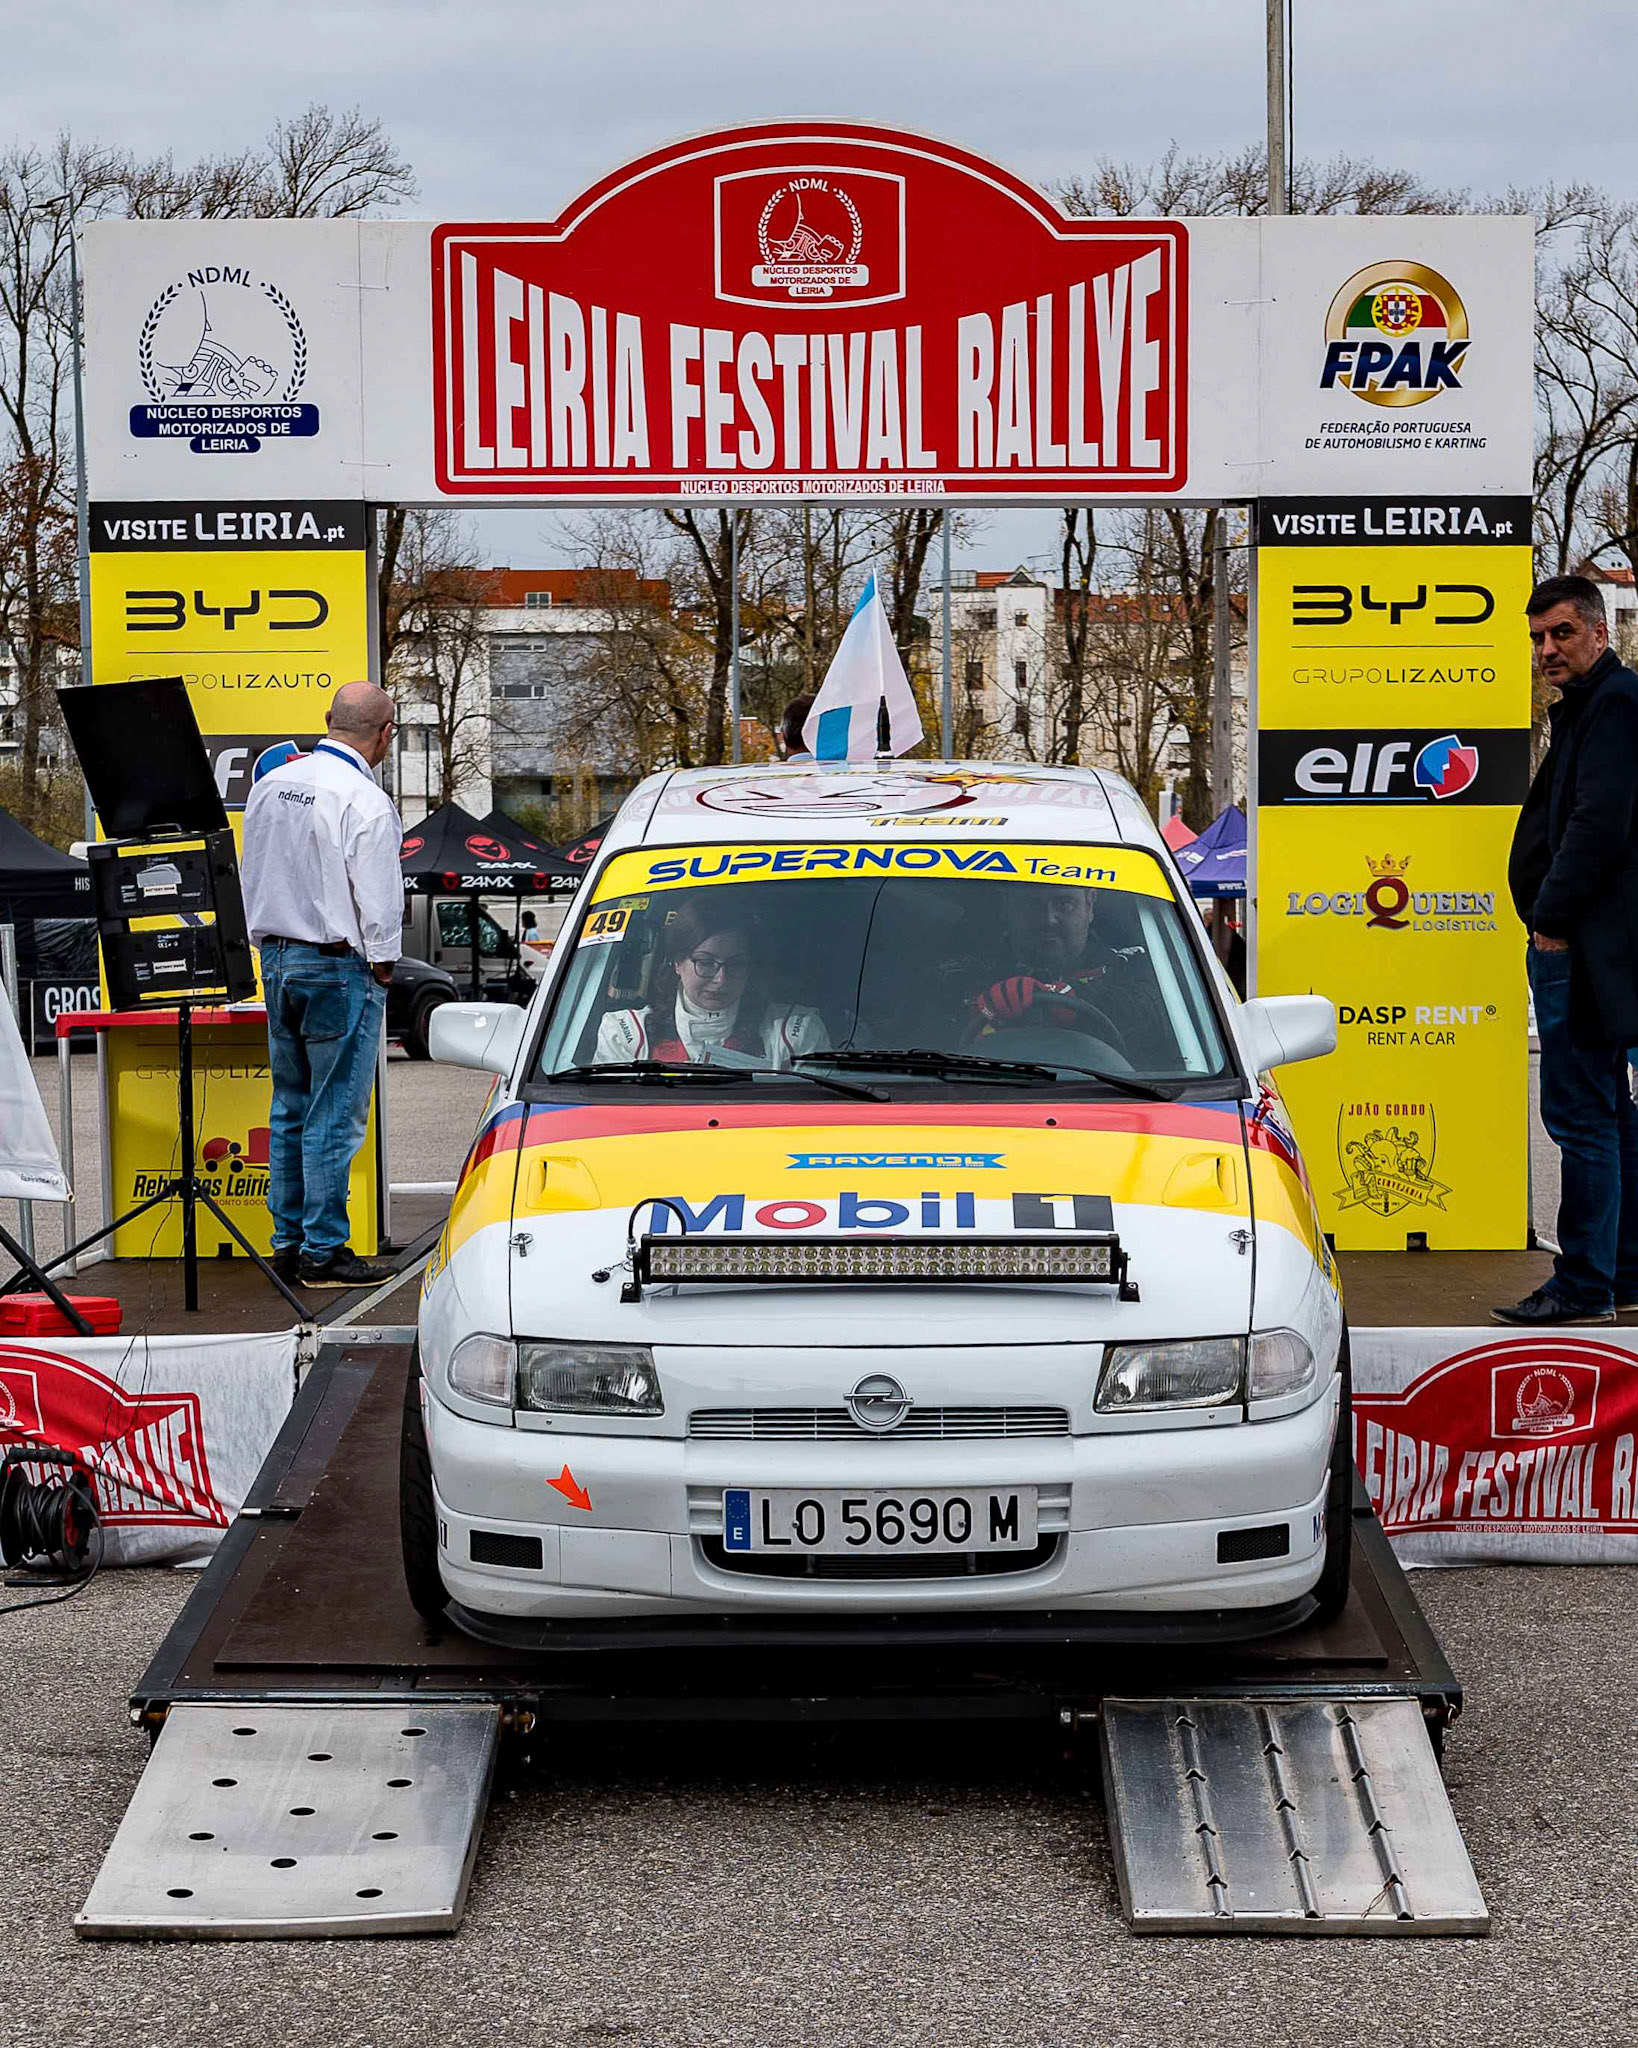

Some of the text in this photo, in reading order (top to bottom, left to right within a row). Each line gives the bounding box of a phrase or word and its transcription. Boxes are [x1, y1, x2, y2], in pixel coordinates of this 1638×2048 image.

[787, 178, 829, 193] NDML
[187, 266, 251, 288] NDML
[802, 266, 858, 275] DESPORTOS
[770, 276, 851, 285] MOTORIZADOS DE
[796, 286, 825, 295] LEIRIA
[461, 247, 1162, 470] LEIRIA FESTIVAL RALLYE
[1320, 341, 1472, 389] FPAK
[146, 404, 302, 420] NÚCLEO DESPORTOS
[158, 422, 291, 436] MOTORIZADOS DE
[1320, 421, 1471, 436] FEDERAÇÃO PORTUGUESA
[201, 437, 249, 451] LEIRIA
[1305, 438, 1486, 449] DE AUTOMOBILISMO E KARTING
[680, 479, 945, 494] NUCLEO DESPORTOS MOTORIZADOS DE LEIRIA
[103, 519, 187, 541] VISITE
[1272, 514, 1356, 536] VISITE
[125, 589, 329, 631] BYD
[1293, 584, 1495, 625] BYD
[128, 673, 331, 690] POLIZAUTO
[1293, 668, 1496, 684] GRUPOLIZAUTO
[1294, 742, 1411, 793] elf
[278, 790, 315, 806] ndml.pt
[646, 848, 1116, 885] SUPERNOVA Team
[461, 876, 514, 888] 24MX
[1286, 877, 1495, 931] LOGIQUEEN
[590, 910, 626, 934] 49
[1413, 919, 1498, 931] LOGÍSTICA
[1339, 1006, 1406, 1024] DASP
[1368, 1032, 1455, 1045] RENT A CAR
[1349, 1102, 1425, 1116] JOÃO GORDO
[808, 1156, 984, 1166] RAVENOL
[650, 1191, 975, 1234] Mobil
[1533, 1368, 1557, 1377] NDML
[1453, 1443, 1599, 1518] FESTIVAL
[762, 1495, 1019, 1546] LO 5690 M
[1456, 1524, 1604, 1533] NUCLEO DESPORTOS MOTORIZADOS DE LEIRIA
[733, 1527, 743, 1541] E
